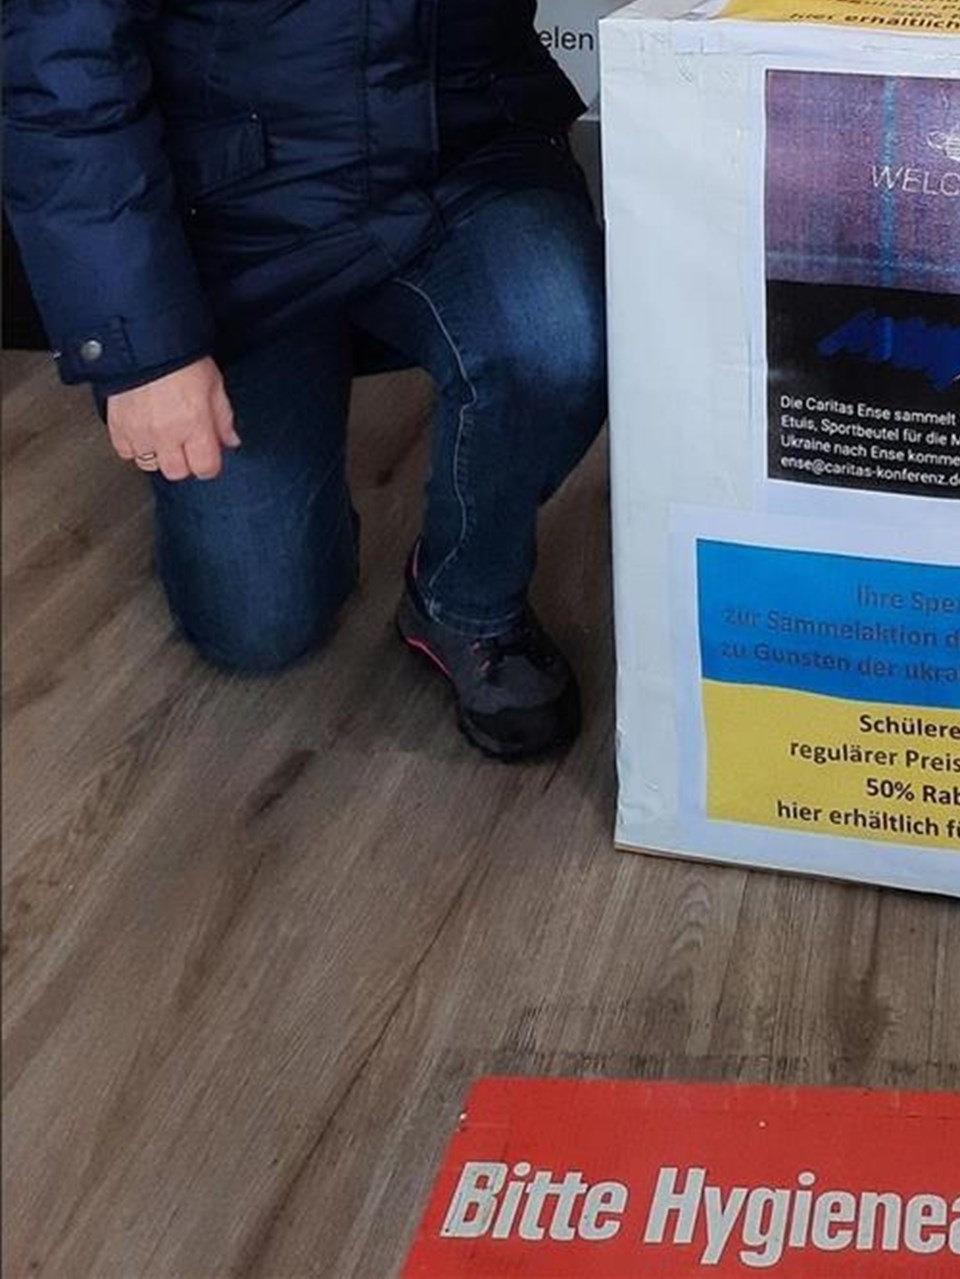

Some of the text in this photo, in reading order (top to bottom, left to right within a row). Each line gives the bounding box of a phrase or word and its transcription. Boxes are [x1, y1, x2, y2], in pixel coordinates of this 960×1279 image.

[780, 395, 803, 409] Die
[805, 397, 854, 415] Caritas
[857, 403, 891, 420] Ense
[894, 410, 956, 426] sammelt
[820, 418, 899, 441] Sportbeutel
[903, 428, 922, 443] für
[926, 431, 948, 446] die
[780, 434, 831, 453] Ukraine
[833, 442, 867, 458] nach
[870, 445, 905, 462] Ense
[857, 584, 904, 610] Ihre
[723, 607, 760, 626] zur
[767, 609, 938, 648] Sammelaktion
[722, 642, 747, 659] zu
[753, 642, 851, 671] Gunsten
[857, 656, 895, 678] der
[790, 741, 898, 765] regulärer
[866, 777, 916, 802] 50%
[776, 800, 823, 822] hier
[828, 808, 940, 837] erhältlich
[439, 1161, 629, 1242] Bitte
